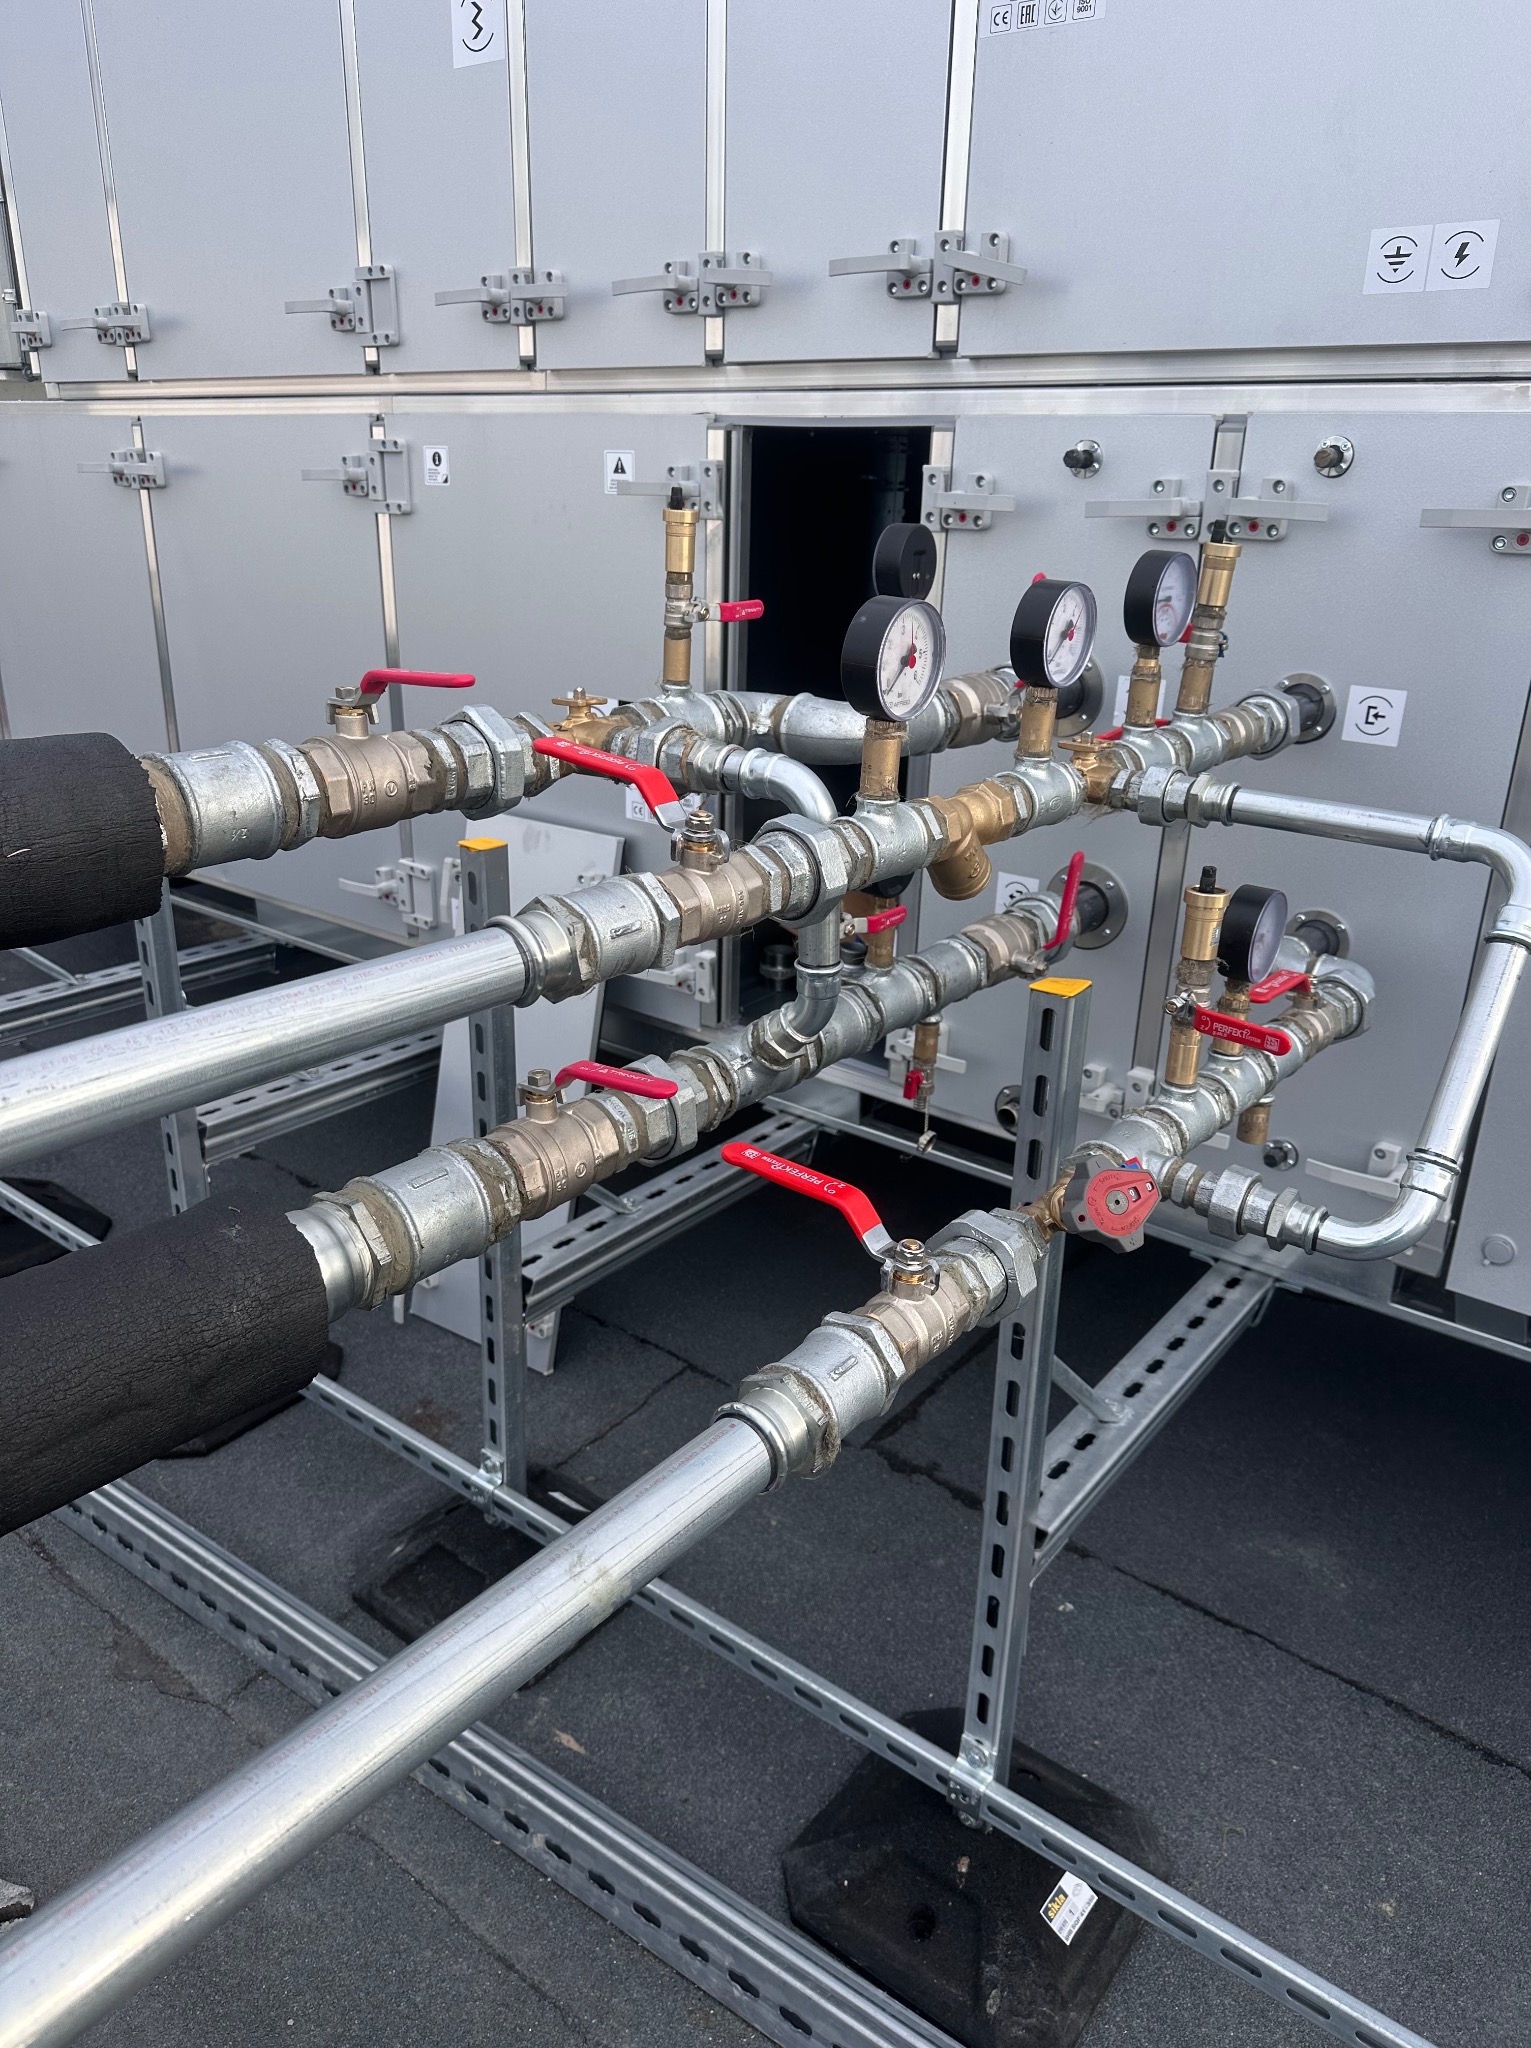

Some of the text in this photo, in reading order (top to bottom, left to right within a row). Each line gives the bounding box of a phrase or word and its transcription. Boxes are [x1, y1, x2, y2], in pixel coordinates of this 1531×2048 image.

[993, 4, 1092, 27] CE EAC 9001
[633, 805, 643, 816] CE
[1212, 1022, 1249, 1039] PERFEKT
[780, 1163, 824, 1185] PERFEKT
[1047, 1893, 1067, 1920] sikla
